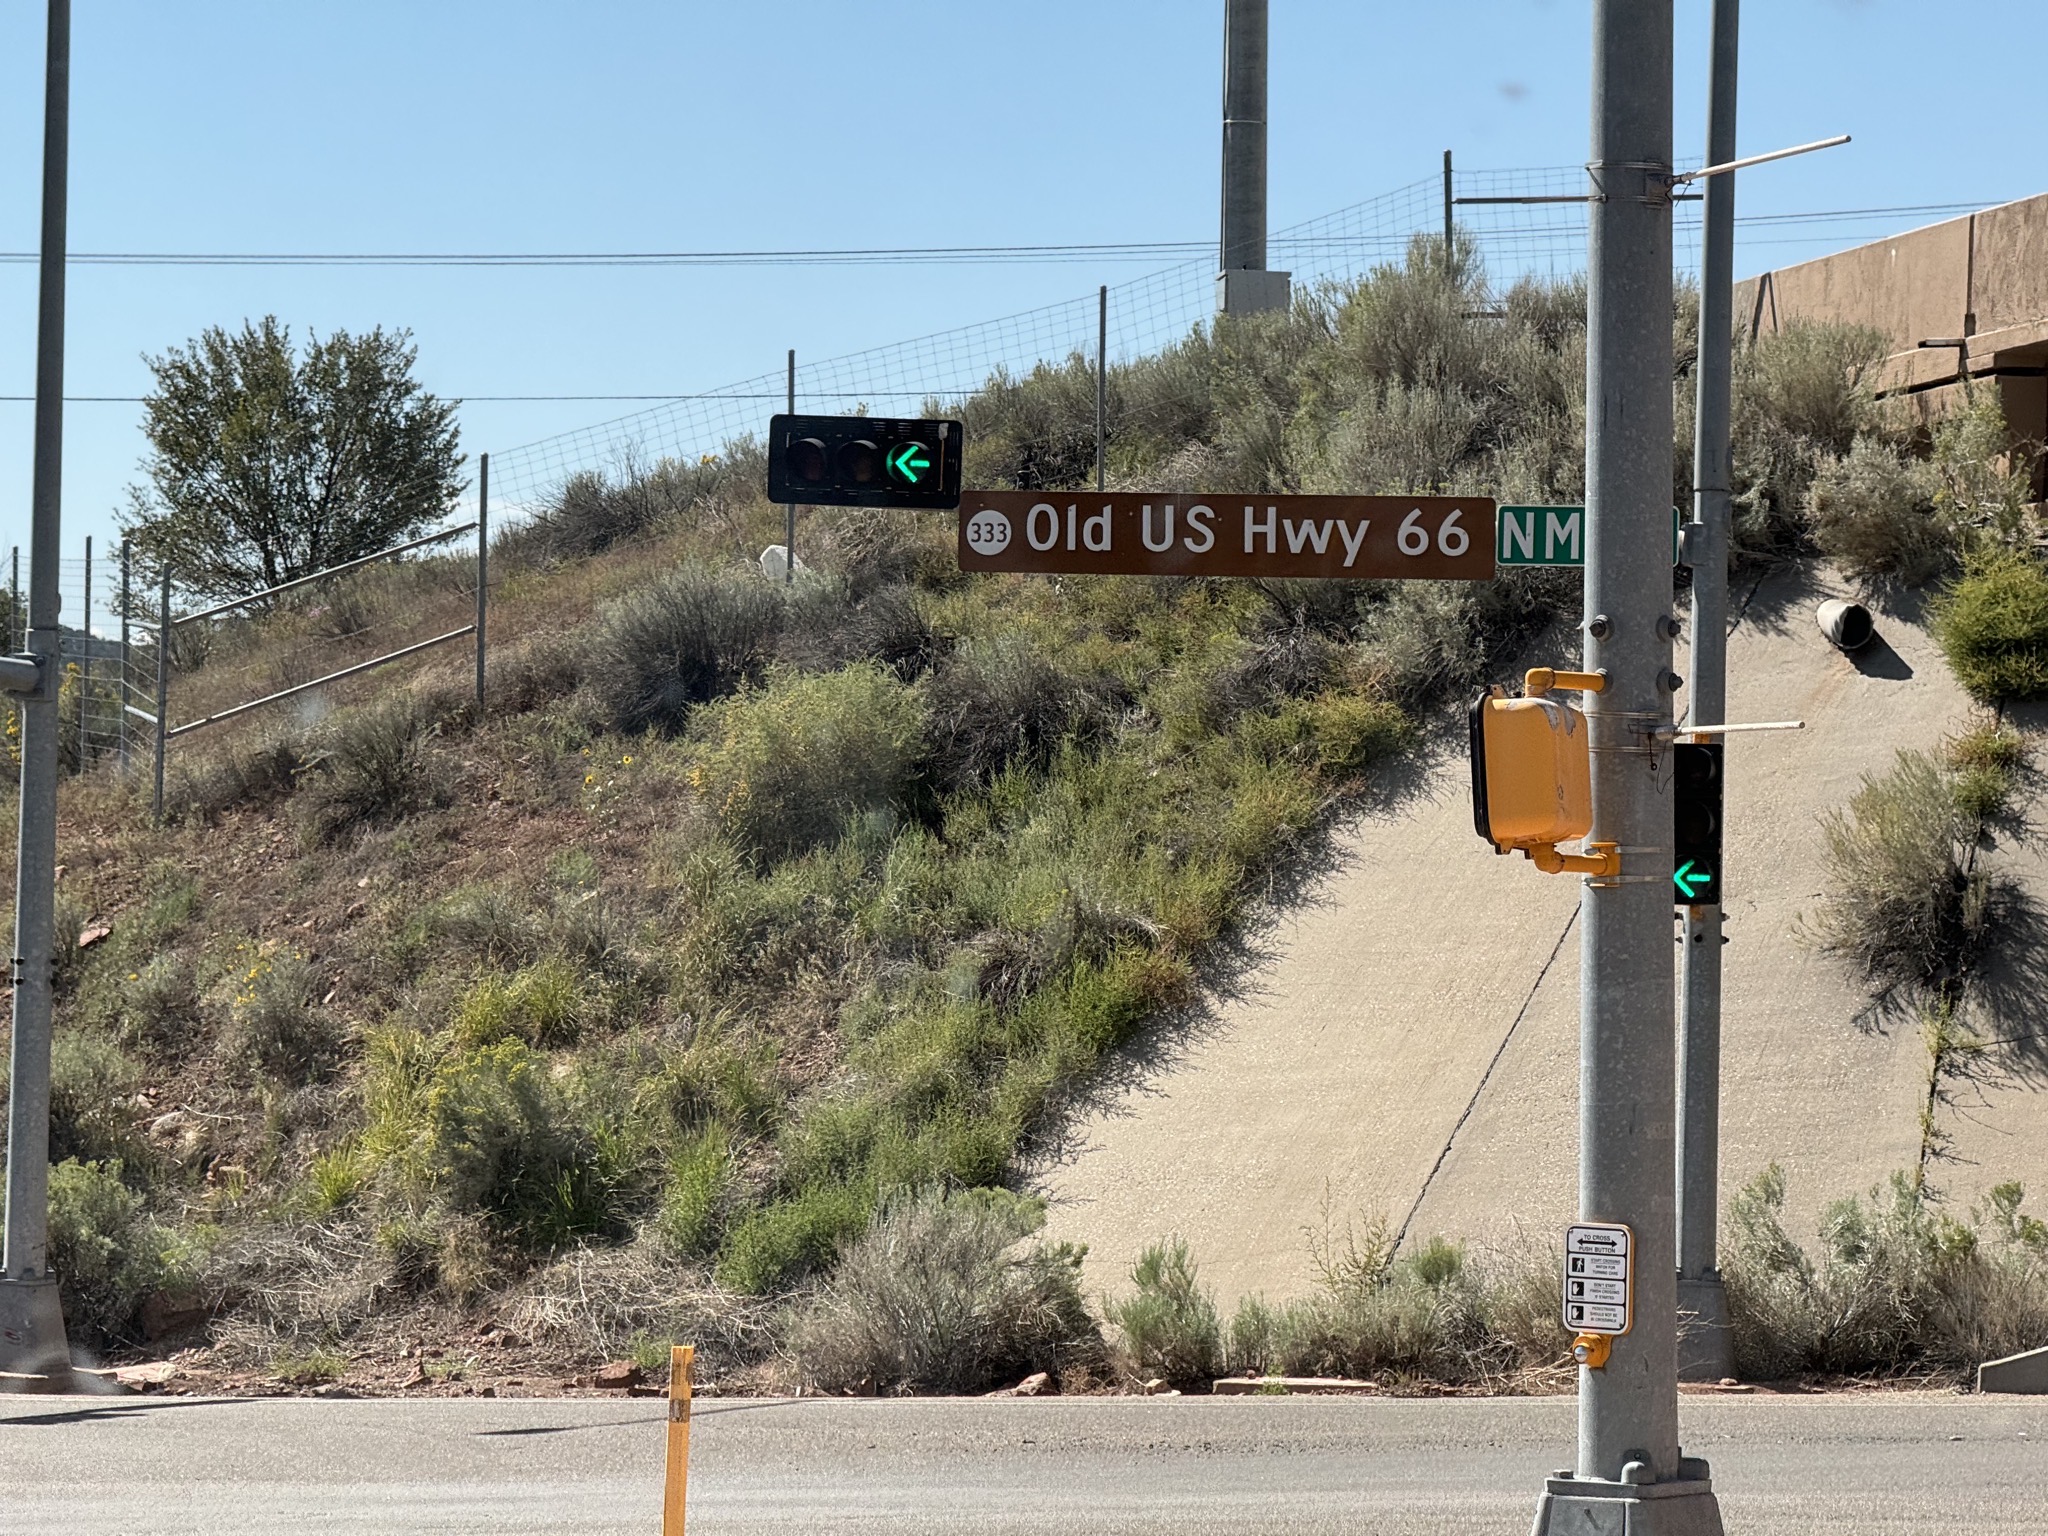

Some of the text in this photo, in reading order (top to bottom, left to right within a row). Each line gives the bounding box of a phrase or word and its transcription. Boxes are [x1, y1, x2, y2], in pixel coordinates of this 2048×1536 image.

[970, 522, 1008, 543] 333
[1026, 503, 1470, 567] Old US Hwy 66
[1503, 511, 1580, 560] NM
